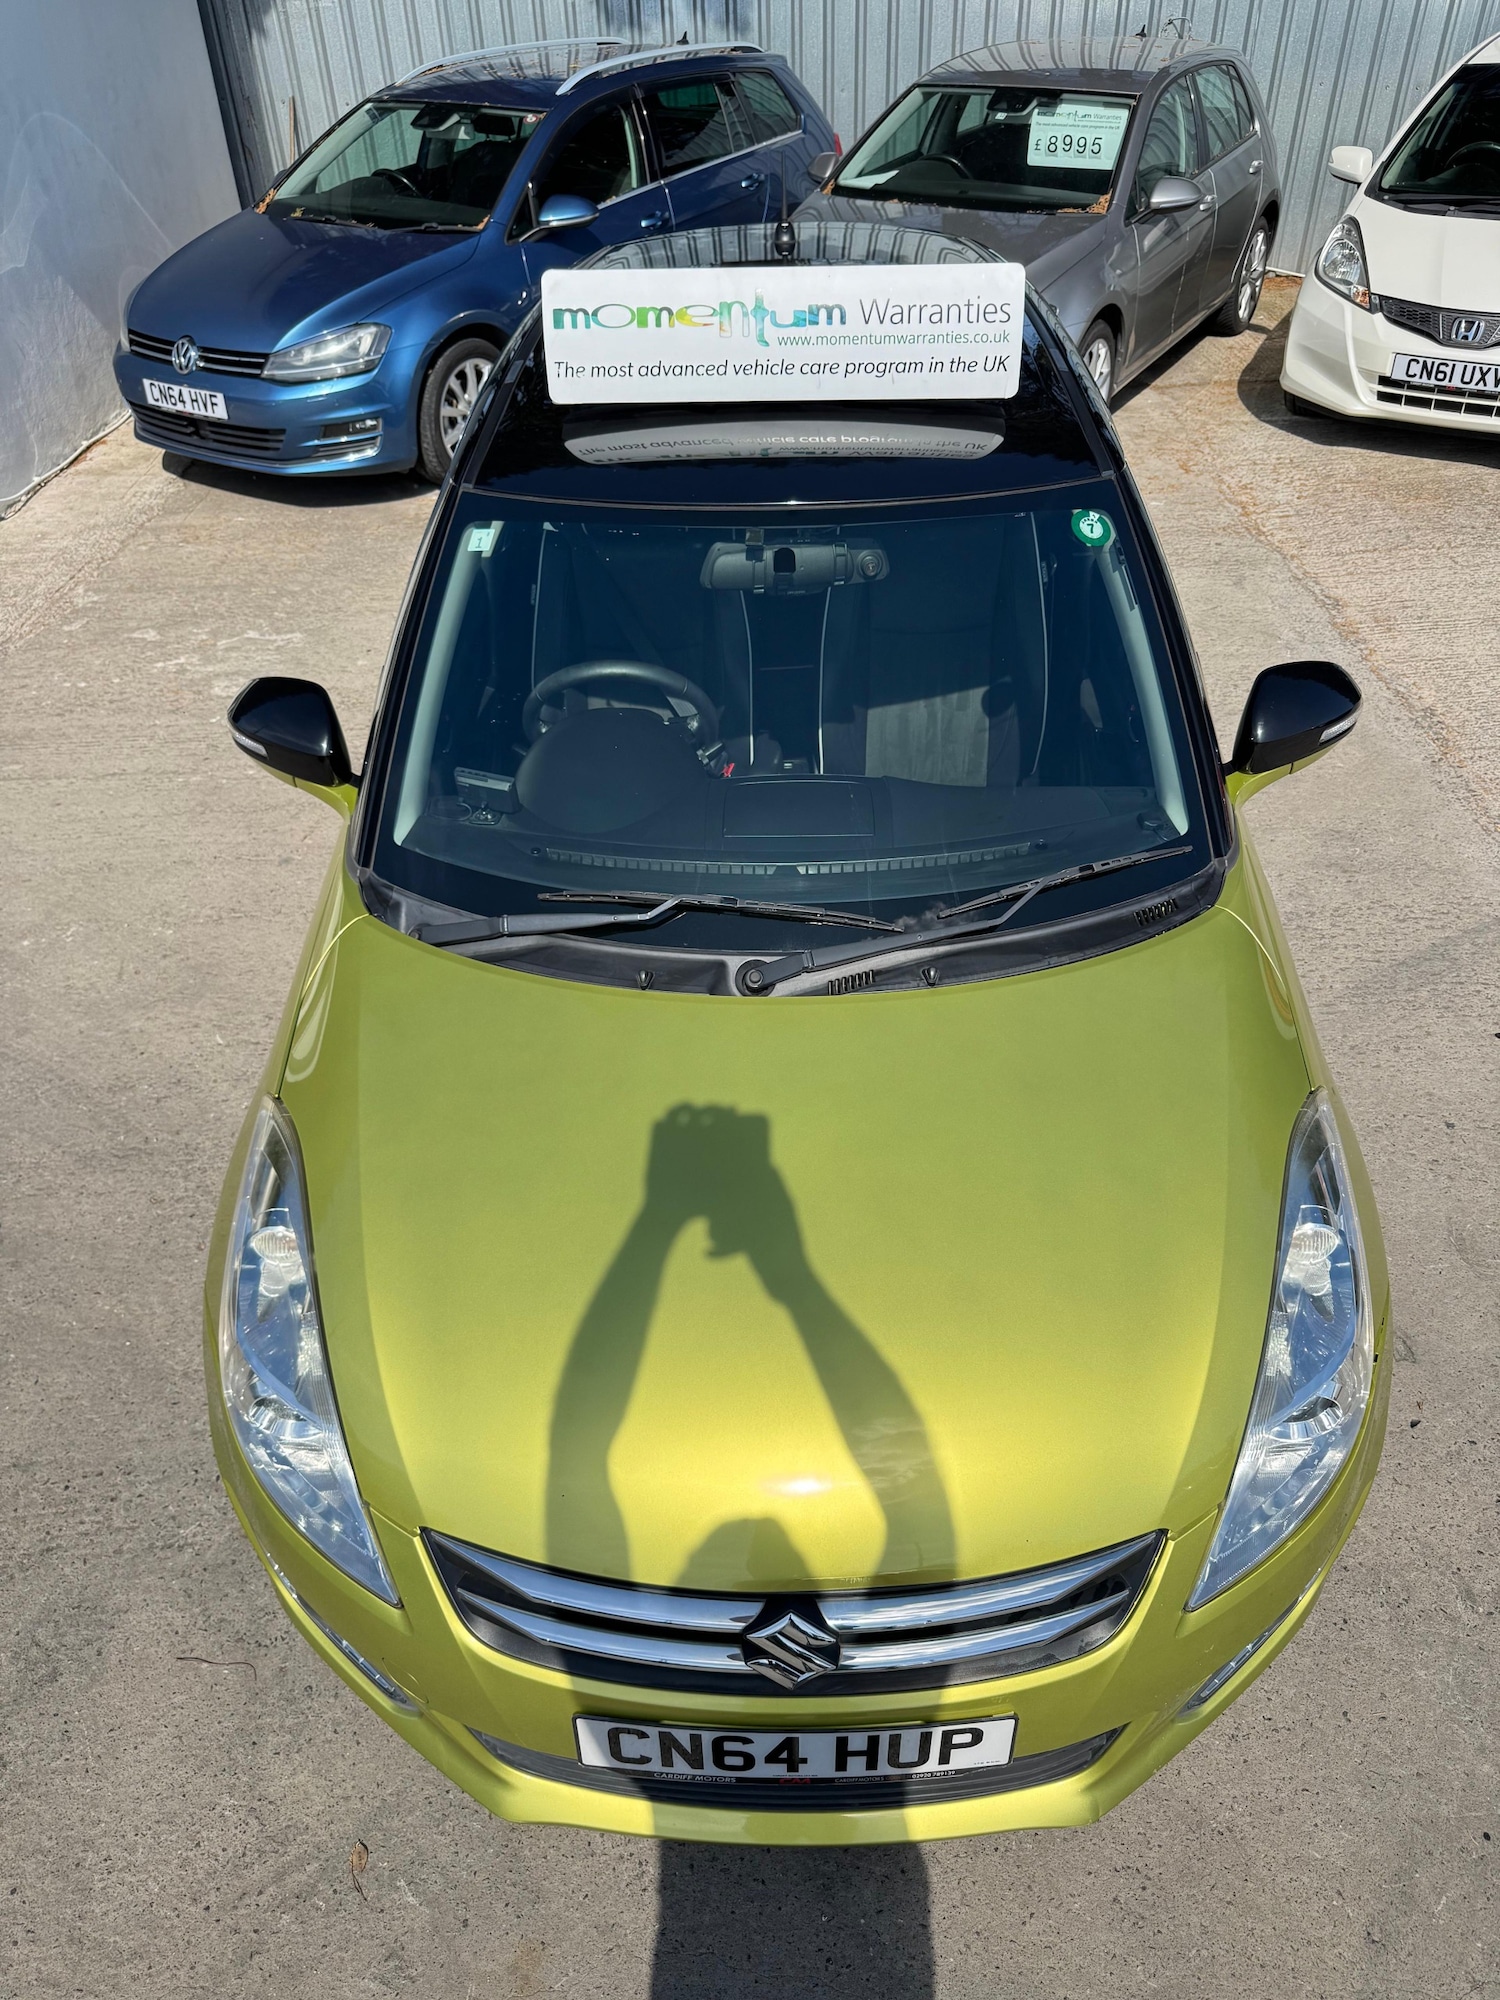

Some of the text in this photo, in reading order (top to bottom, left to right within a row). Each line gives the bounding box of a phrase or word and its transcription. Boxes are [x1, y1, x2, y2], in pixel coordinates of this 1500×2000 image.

[552, 288, 1011, 347] momentum Warranties
[777, 329, 1010, 347] www.momentumwarranties.co.uk
[554, 354, 1010, 378] The most advanced vehicle care program in the UK
[149, 382, 218, 415] CN64 HVF
[607, 1726, 984, 1773] CN64 HUP
[653, 1772, 737, 1784] CARDIFF MOTORS
